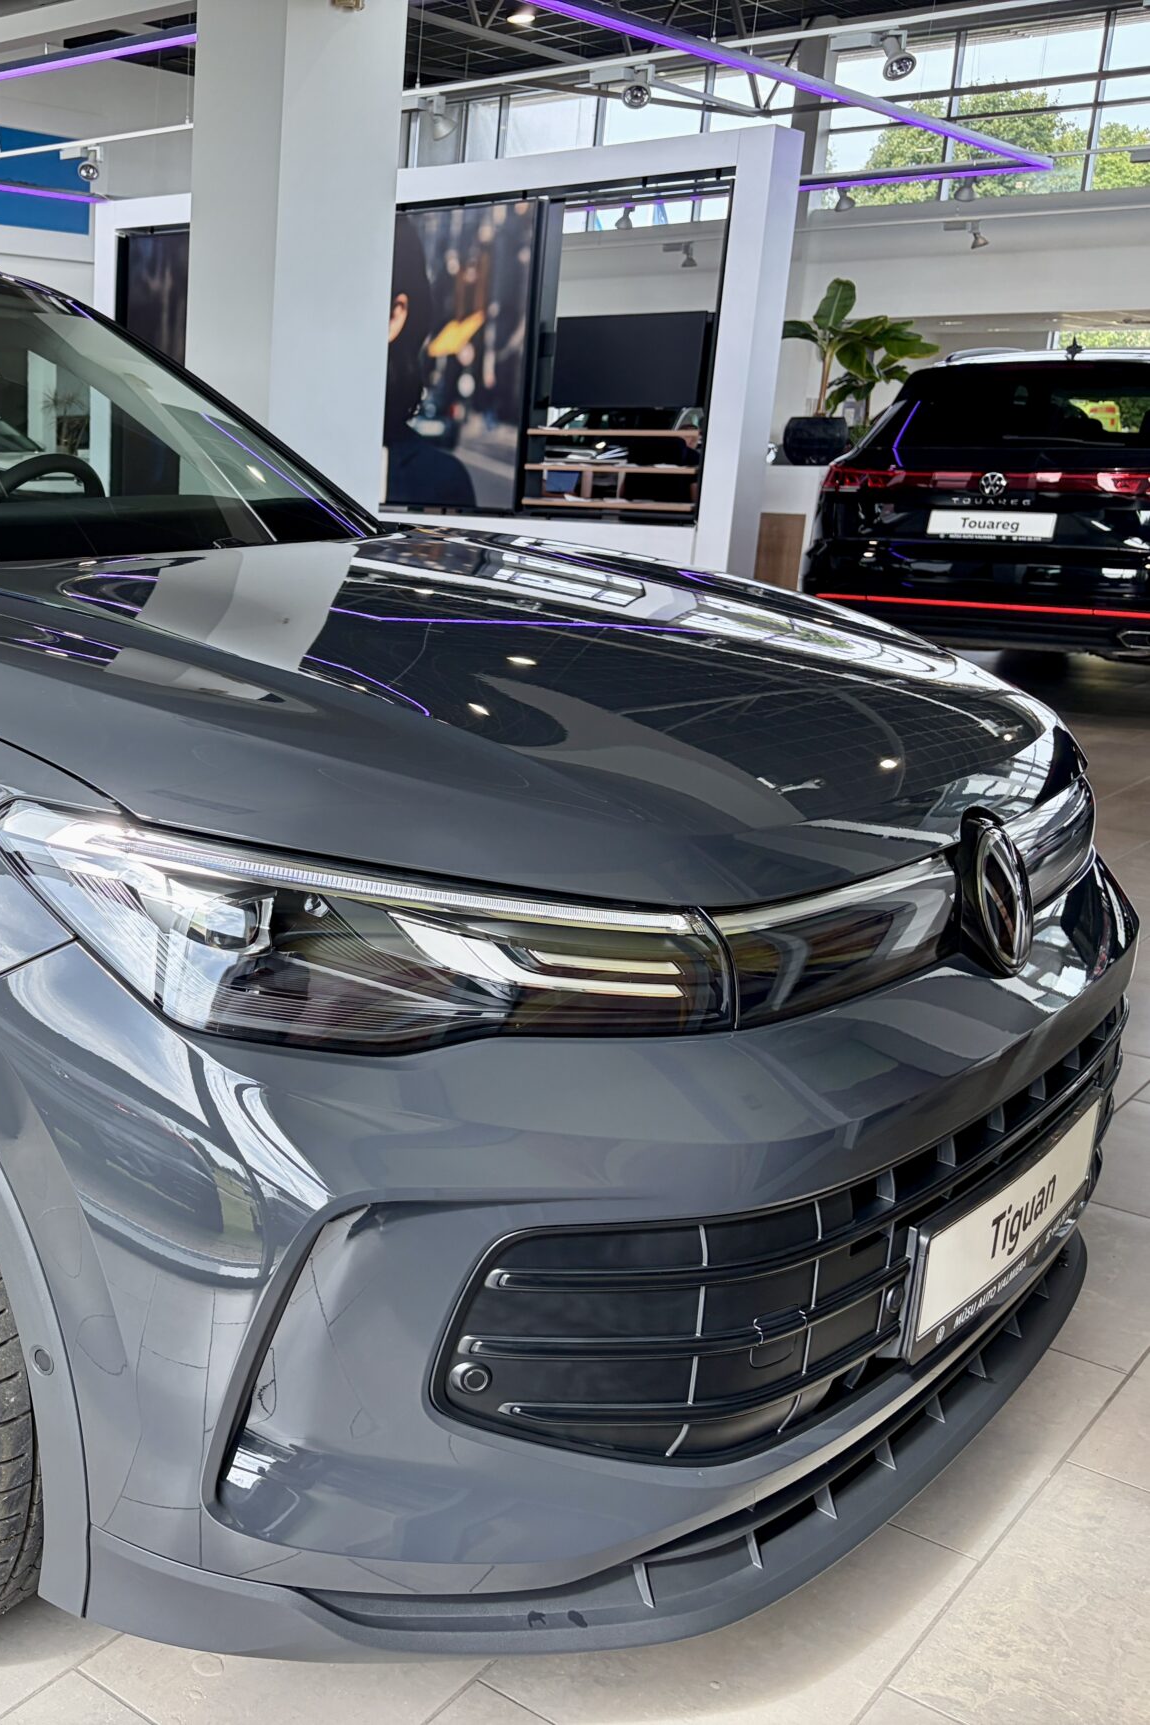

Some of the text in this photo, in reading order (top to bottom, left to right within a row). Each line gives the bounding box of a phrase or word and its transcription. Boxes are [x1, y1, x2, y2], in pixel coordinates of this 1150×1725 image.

[951, 497, 1032, 506] TOUAREG
[961, 516, 1020, 533] Touareg
[990, 1173, 1057, 1260] Tiguan
[976, 1285, 997, 1311] AUTO
